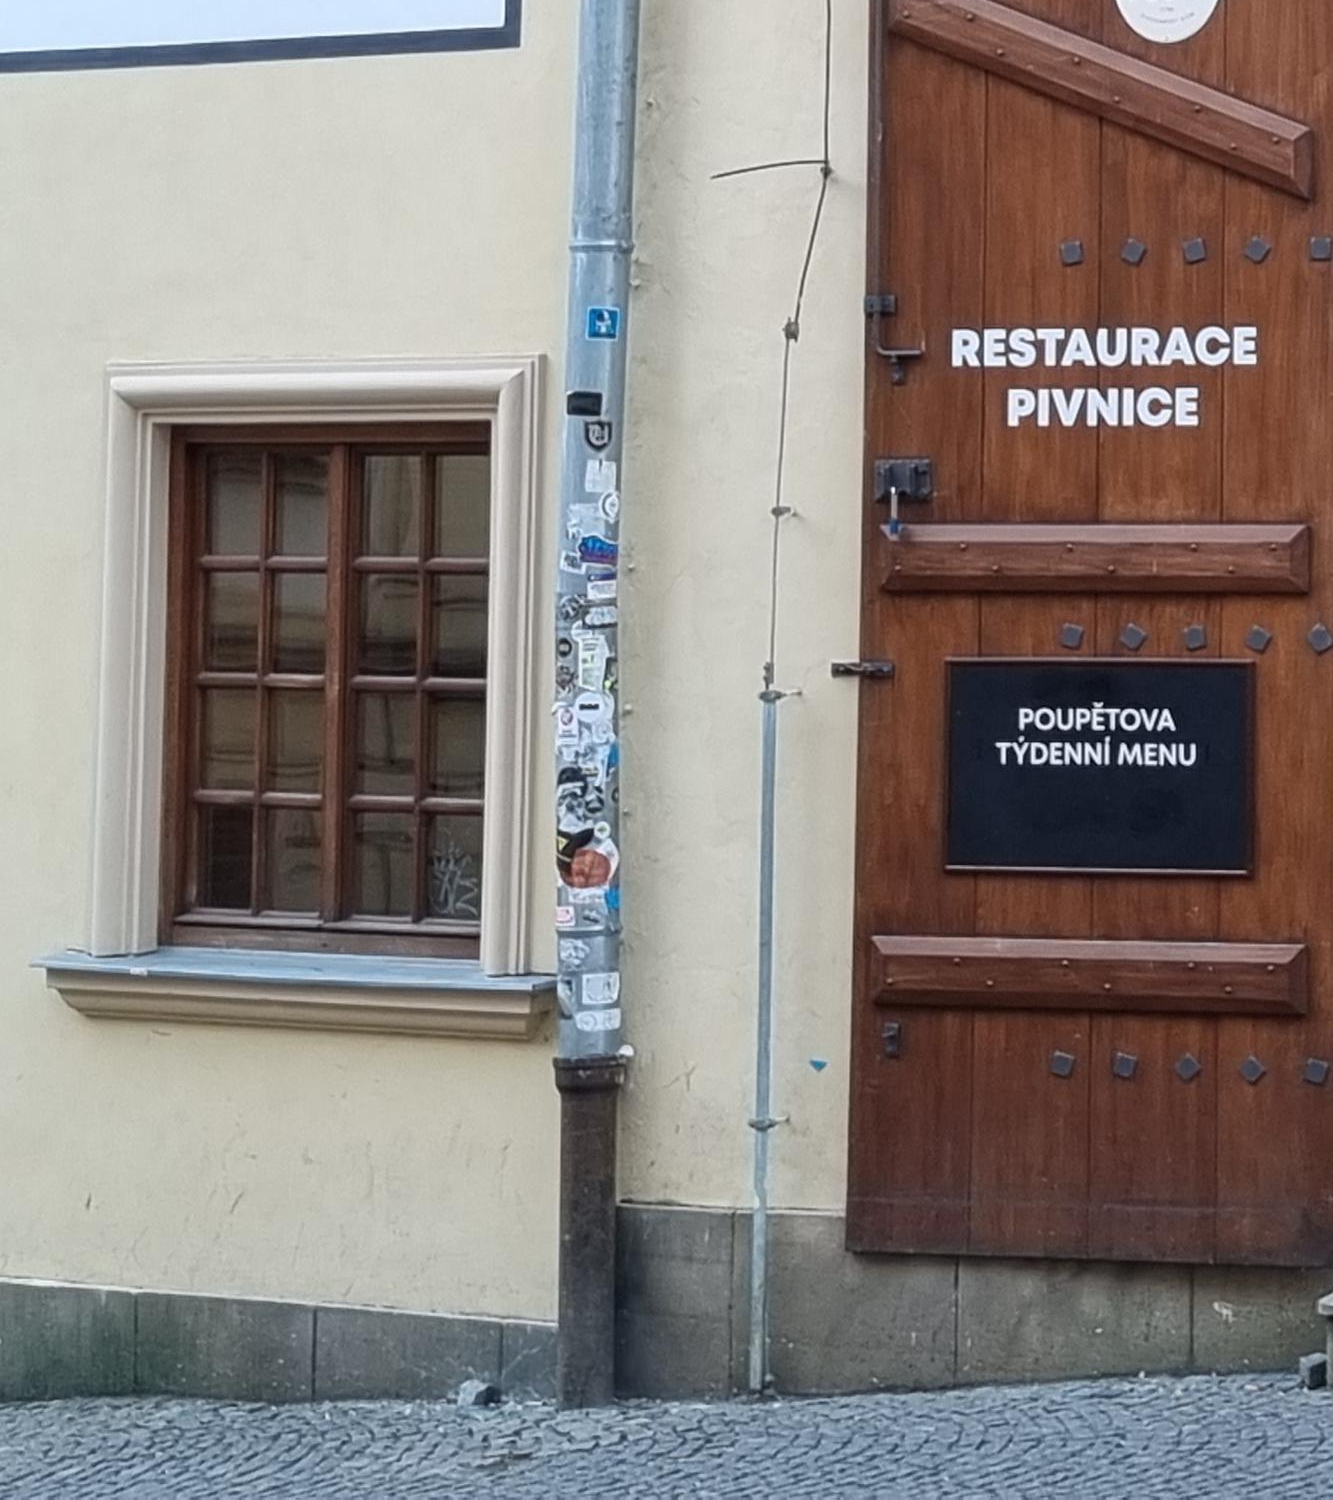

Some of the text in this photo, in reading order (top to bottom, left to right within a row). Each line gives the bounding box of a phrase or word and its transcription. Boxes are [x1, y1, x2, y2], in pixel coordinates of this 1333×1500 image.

[951, 326, 1258, 368] RESTAURACE
[1007, 387, 1199, 427] PIVNICE
[1018, 701, 1177, 732] POUPĚTOVA
[995, 735, 1197, 767] TÝDENNÍ MENU
